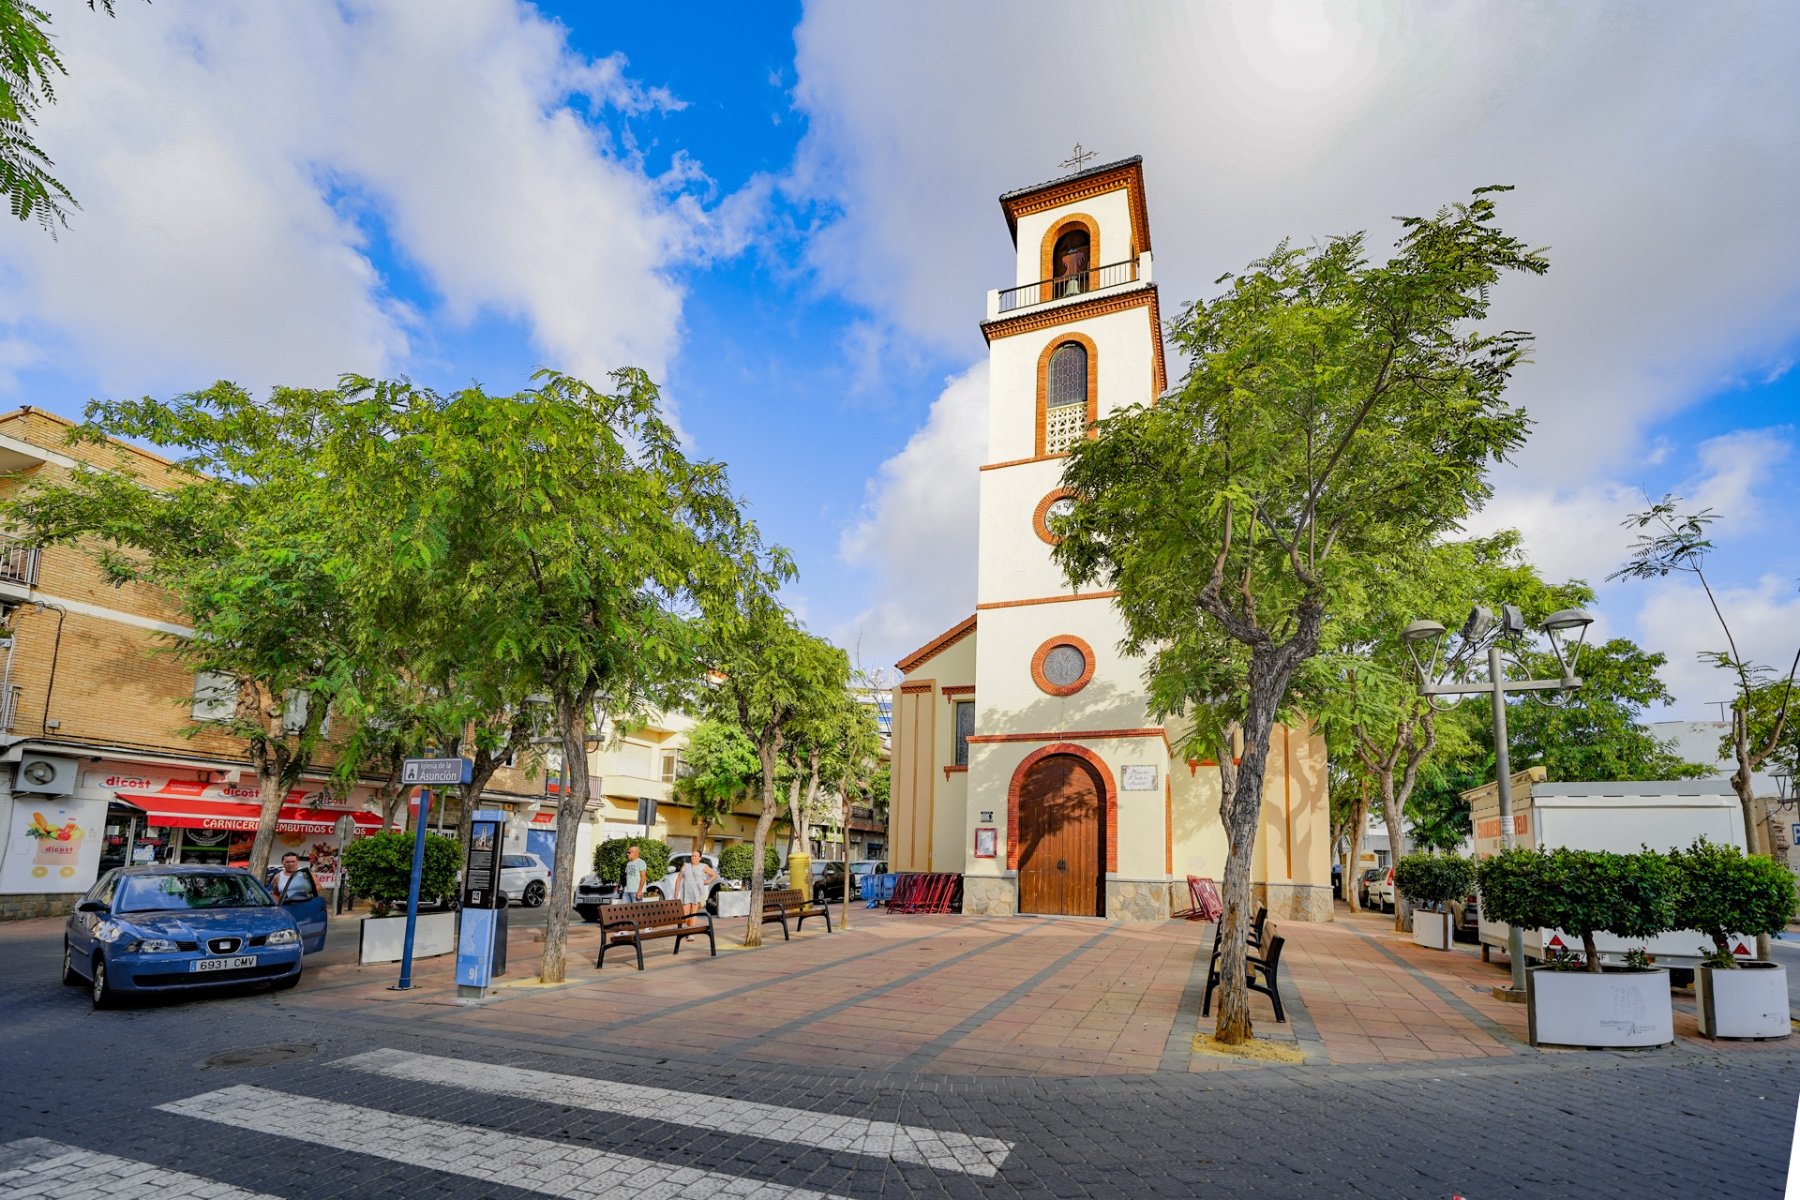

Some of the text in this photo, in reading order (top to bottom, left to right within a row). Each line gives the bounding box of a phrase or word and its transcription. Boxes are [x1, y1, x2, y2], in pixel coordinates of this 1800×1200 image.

[446, 761, 452, 769] la
[420, 769, 457, 781] Asunción
[106, 776, 151, 789] dicost
[223, 786, 260, 798] dicost
[203, 818, 258, 830] CARNICERI
[275, 823, 326, 834] EMBUTIDOS
[200, 957, 255, 970] 6931 CMV
